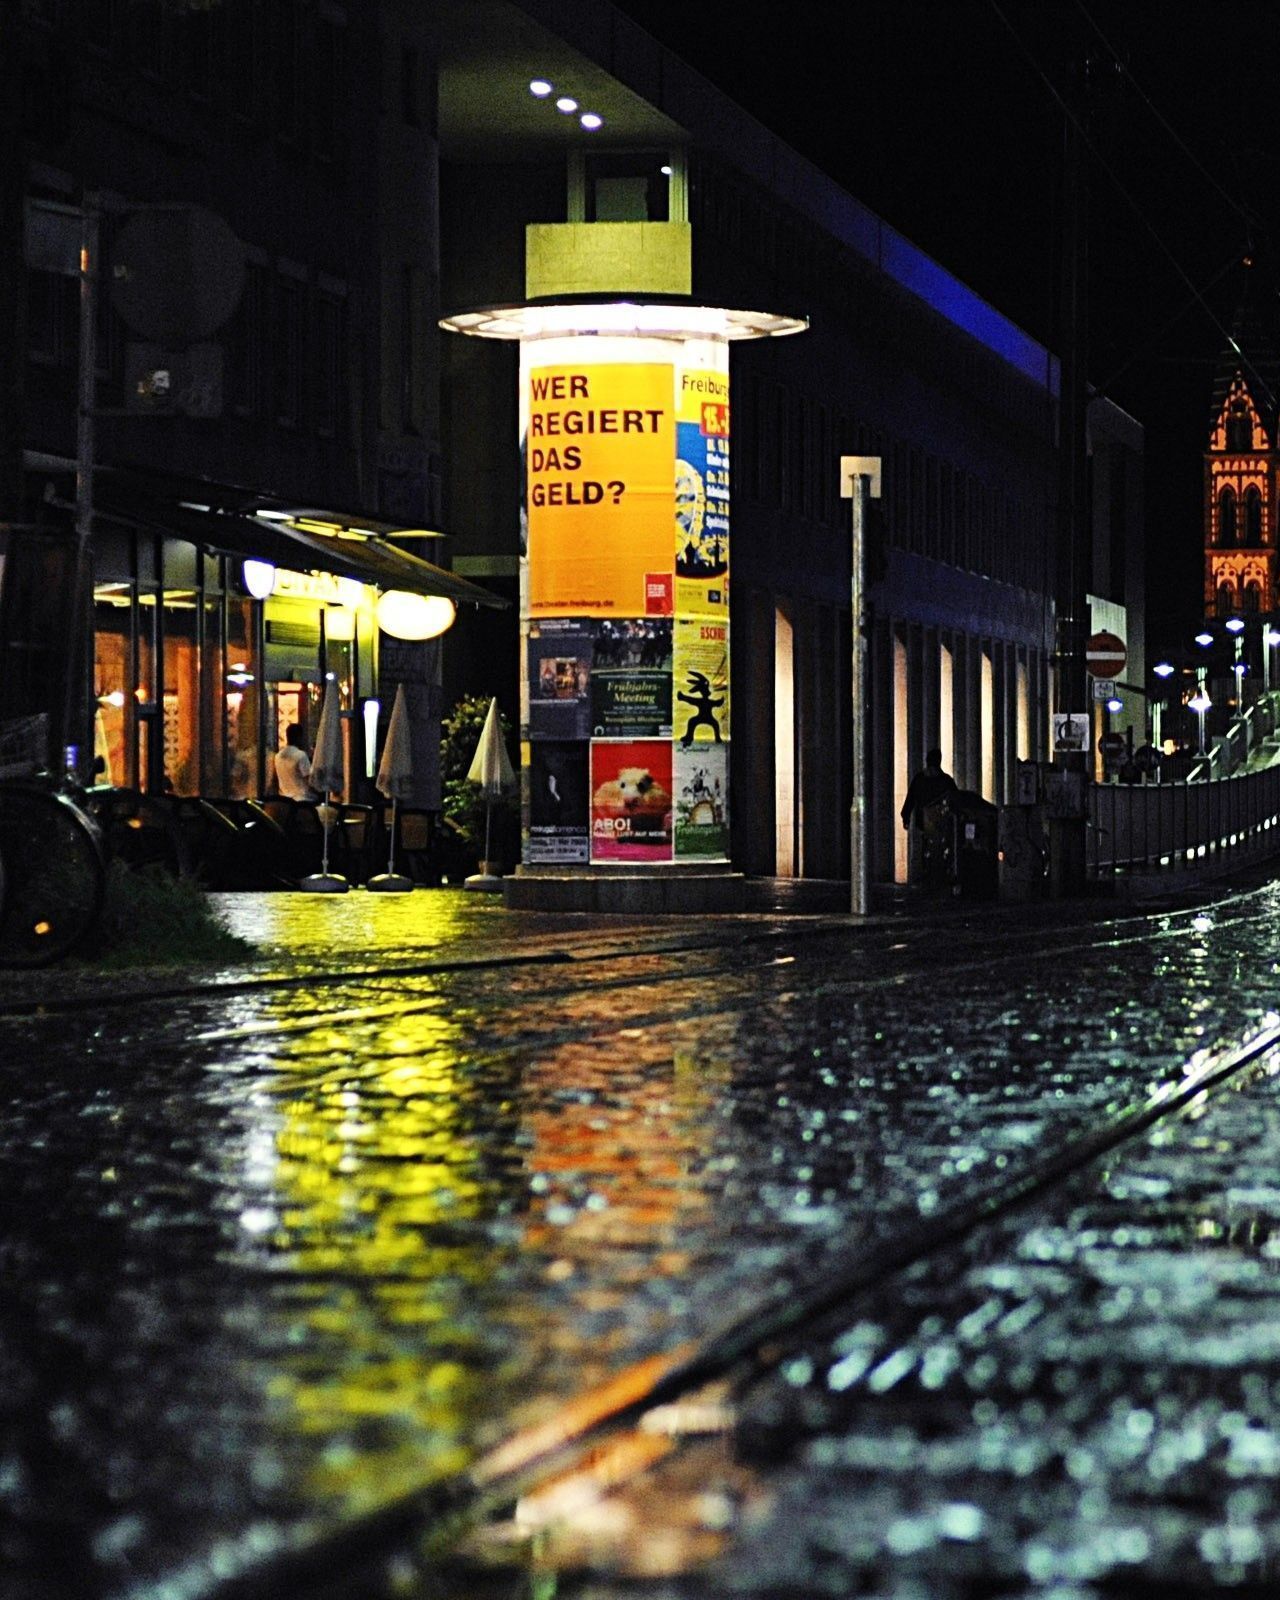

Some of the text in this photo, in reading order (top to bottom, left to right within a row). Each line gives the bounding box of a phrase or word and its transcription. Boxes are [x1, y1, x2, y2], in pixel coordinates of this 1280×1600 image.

[532, 375, 589, 400] WER
[532, 410, 663, 436] REGIERT
[532, 446, 581, 472] DAS
[532, 481, 625, 506] GELD?
[614, 692, 655, 704] Meeting
[594, 818, 631, 831] ABO!
